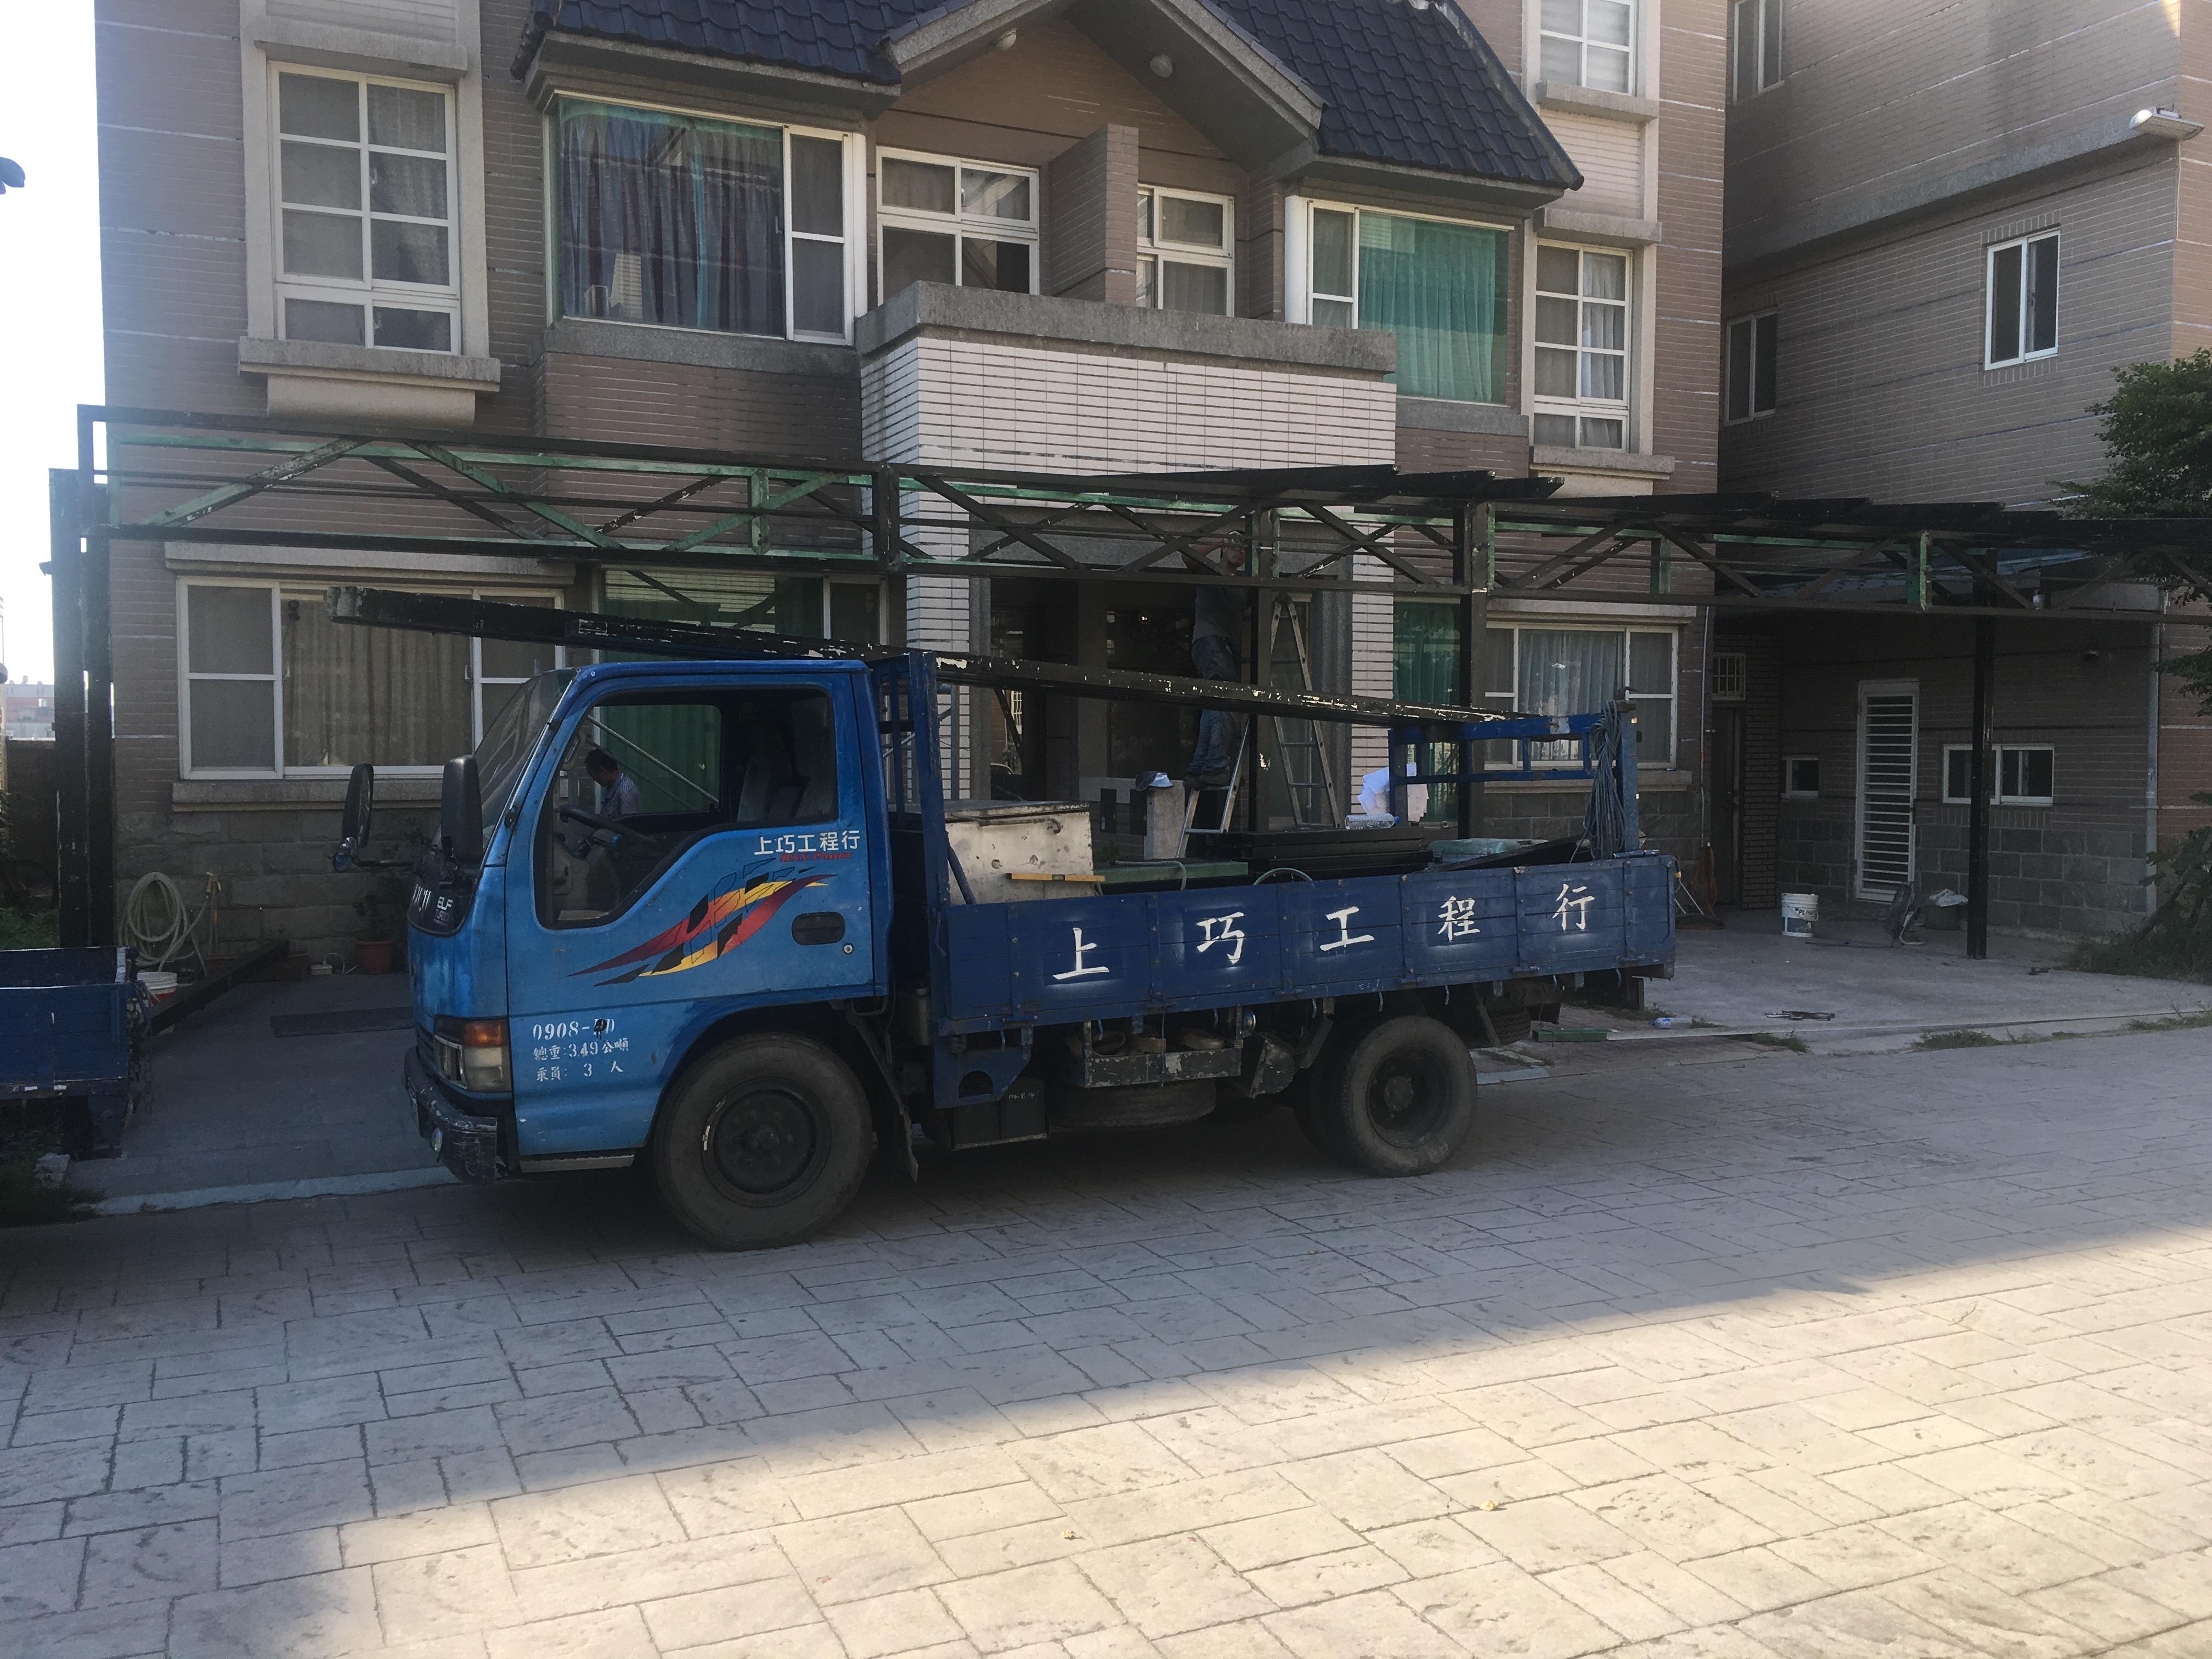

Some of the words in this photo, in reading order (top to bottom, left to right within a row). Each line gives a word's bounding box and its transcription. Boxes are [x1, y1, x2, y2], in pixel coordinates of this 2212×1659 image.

[754, 830, 860, 855] 上巧工程行
[437, 896, 454, 911] ELF
[1053, 883, 1595, 981] 上巧工程行
[583, 1063, 592, 1077] 3
[610, 1060, 624, 1073] 人
